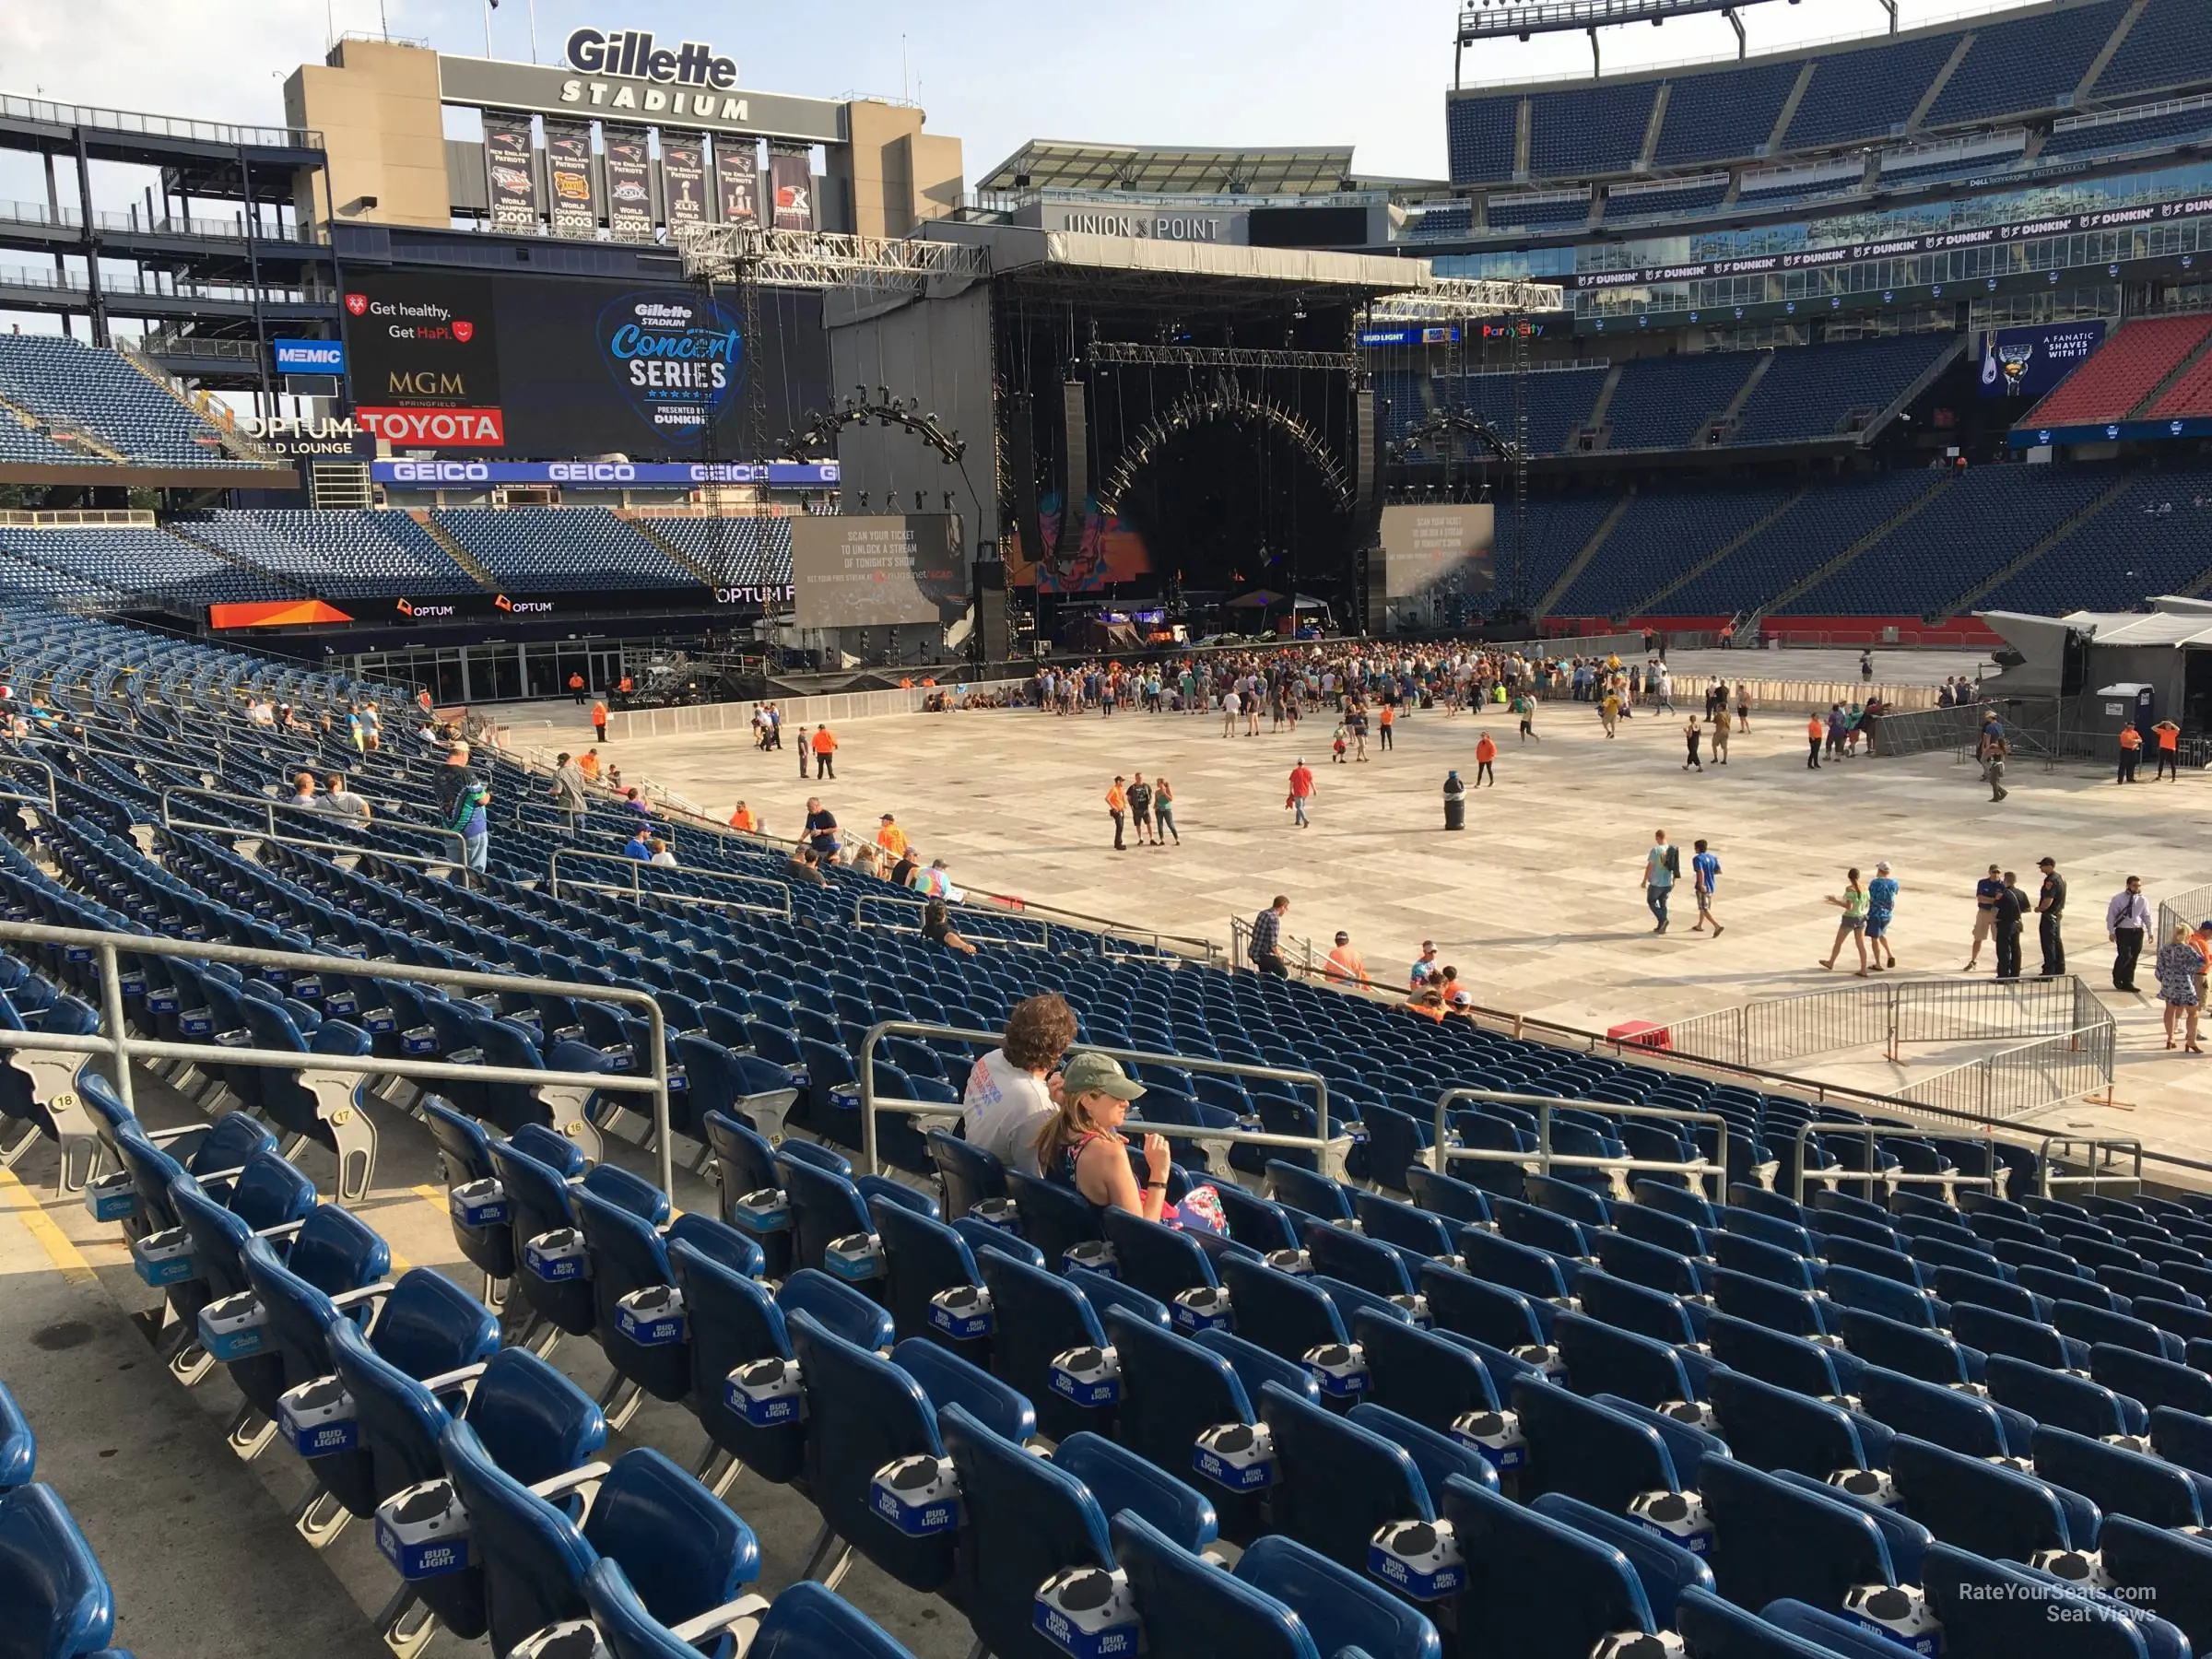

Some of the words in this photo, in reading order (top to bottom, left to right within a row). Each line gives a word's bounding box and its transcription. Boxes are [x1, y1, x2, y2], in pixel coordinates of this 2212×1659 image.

[565, 26, 738, 90] Gillette
[560, 80, 748, 121] STADIUM
[504, 149, 530, 158] ENGLAND
[495, 155, 526, 164] PATRIOTS
[555, 160, 584, 170] PATRIOTS
[614, 167, 643, 175] PATRIOTS
[671, 171, 699, 180] PATRIOTS
[725, 176, 752, 184] PATRIOTS
[500, 197, 526, 206] WORLD
[560, 202, 585, 210] WORLD
[674, 202, 700, 212] XLIX
[494, 204, 534, 213] CHAMPIONS
[555, 208, 593, 218] CHAMPIONS
[619, 206, 643, 215] WORLD
[498, 212, 533, 223] 2001
[614, 214, 651, 222] CHAMPIONS
[676, 211, 699, 220] WORLD
[2101, 208, 2154, 224] DUNKIN'
[557, 216, 593, 228] 2003
[615, 221, 651, 232] 2004
[1068, 214, 1131, 237] UNION
[1157, 218, 1219, 240] POINT
[2022, 219, 2072, 235] DUNKIN'
[1946, 230, 1994, 245] DUNKIN'
[1873, 240, 1919, 255] DUNKIN'
[1803, 249, 1846, 264] DUNKIN'
[1732, 258, 1776, 271] DUNKIN'
[1664, 266, 1707, 278] DUNKIN'
[1596, 272, 1638, 284] DUNKIN'
[371, 302, 396, 315] Get
[399, 302, 451, 321] healthy.
[634, 303, 693, 319] Gillette
[641, 318, 686, 327] STADIUM
[389, 325, 415, 338] Get
[1382, 333, 1404, 341] LIGHT
[2053, 333, 2094, 342] FANATIC
[2049, 341, 2088, 351] SHAVES
[278, 348, 341, 364] MEMIC
[2049, 349, 2074, 359] WITH
[629, 359, 726, 389] SERIES
[388, 371, 465, 394] MGM
[657, 406, 695, 415] PRESENTED
[361, 414, 500, 440] TOYOTA
[291, 442, 353, 453] LOUNGE
[394, 464, 488, 480] GEICO
[548, 464, 636, 481] GEICO
[690, 465, 769, 481] GEICO
[890, 530, 914, 541] TICKET
[889, 544, 917, 554] STREAM
[414, 606, 453, 617] OPTUM
[512, 603, 552, 613] OPTUM
[57, 1095, 72, 1107] 18
[337, 1110, 349, 1122] 17
[571, 1123, 581, 1132] 16
[771, 1135, 780, 1144] 15
[480, 1212, 500, 1220] LIGHT
[553, 1267, 574, 1276] LIGHT
[967, 1324, 985, 1333] LIGHT
[653, 1330, 677, 1339] LIGHT
[1094, 1386, 1109, 1394] BUD
[1091, 1392, 1112, 1400] LIGHT
[769, 1403, 787, 1411] BUD
[765, 1408, 790, 1418] LIGHT
[318, 1430, 341, 1439] BUD
[314, 1436, 347, 1447] LIGHT
[1203, 1453, 1219, 1466] BUD
[1200, 1460, 1222, 1476] LIGHT
[1244, 1469, 1261, 1477] BUD
[1241, 1475, 1264, 1483] LIGHT
[881, 1492, 897, 1506] BUD
[879, 1500, 899, 1520] LIGHT
[925, 1510, 946, 1519] BUD
[922, 1515, 949, 1526] LIGHT
[423, 1549, 451, 1560] BUD
[419, 1557, 455, 1570] LIGHT
[1385, 1558, 1404, 1574] BUD
[1382, 1565, 1408, 1583] LIGHT
[1435, 1573, 1454, 1583] BUD
[1432, 1580, 1456, 1590] LIGHT
[1050, 1611, 1069, 1631] BUD
[1045, 1620, 1072, 1643] LIGHT
[1102, 1634, 1124, 1644] BUD
[1098, 1641, 1128, 1654] LIGHT
